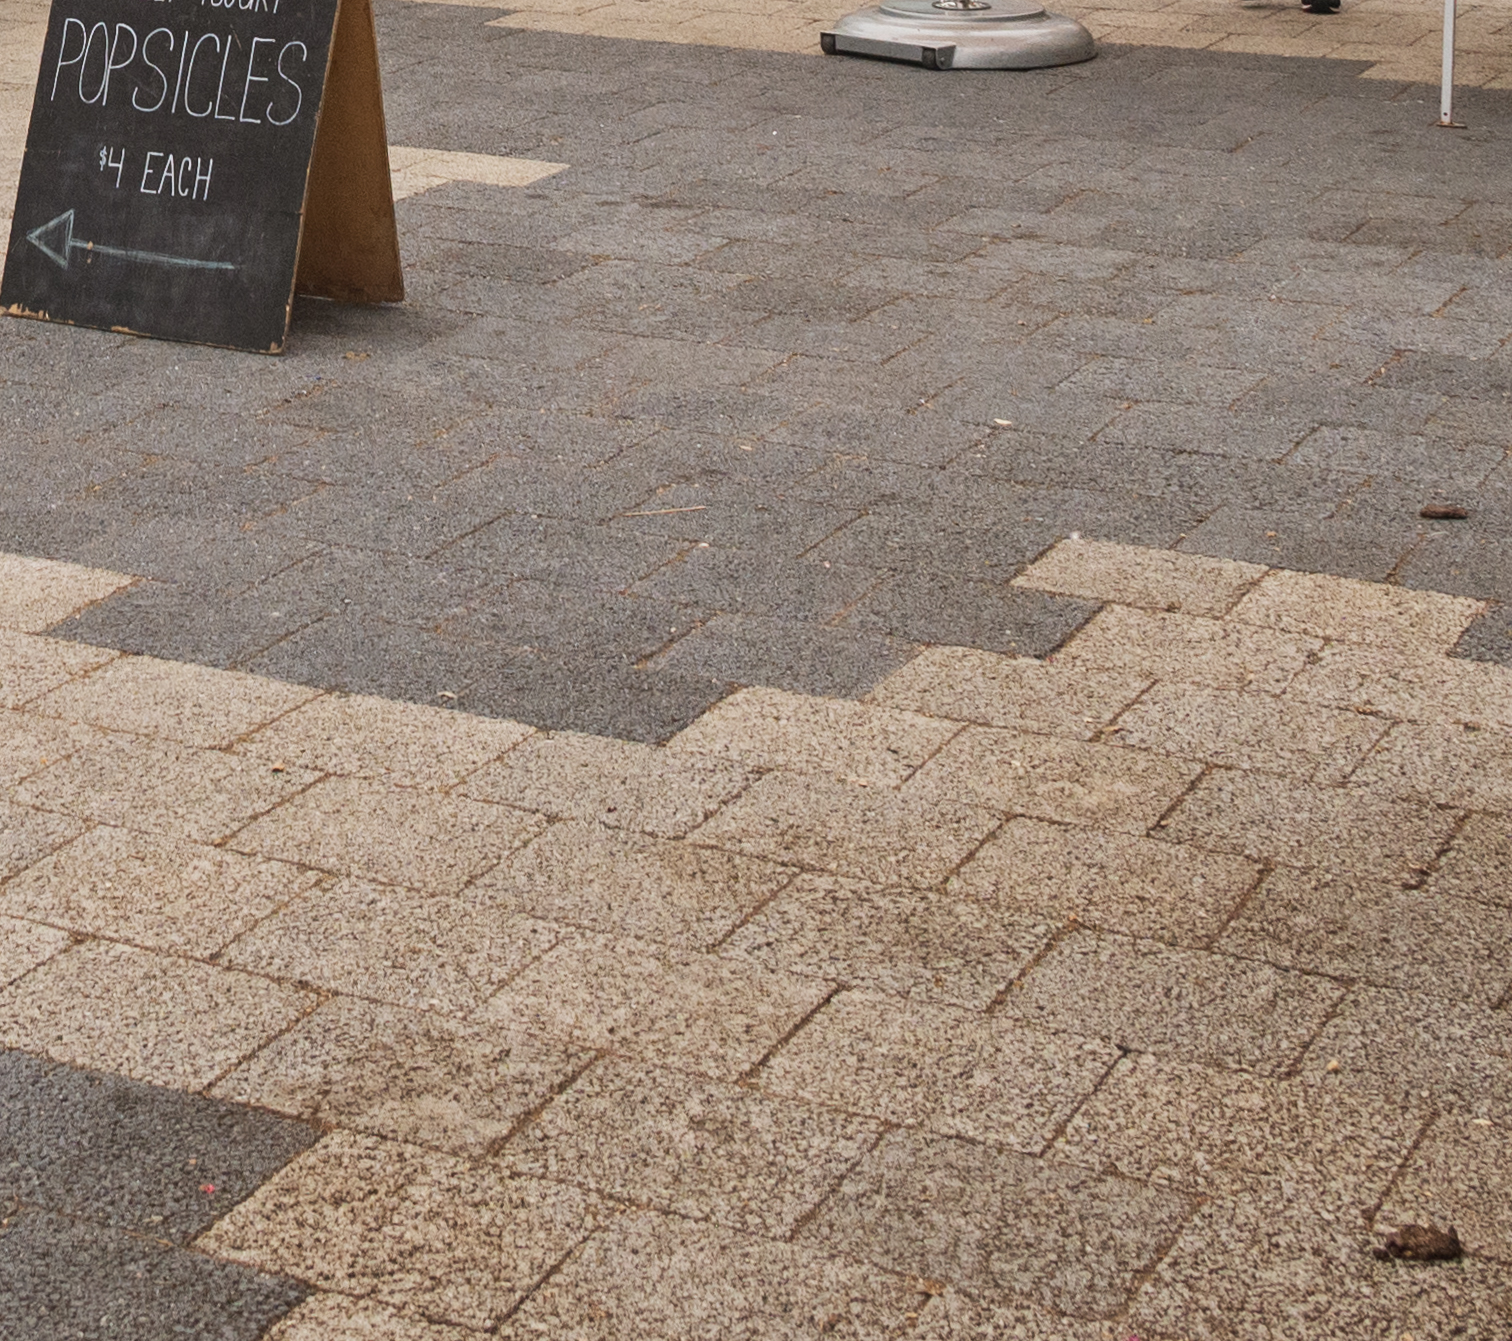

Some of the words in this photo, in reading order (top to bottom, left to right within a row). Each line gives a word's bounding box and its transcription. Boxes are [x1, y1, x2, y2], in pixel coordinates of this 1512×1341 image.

[50, 17, 308, 127] POPSICLES
[99, 146, 126, 189] $4
[139, 150, 214, 202] EACH
